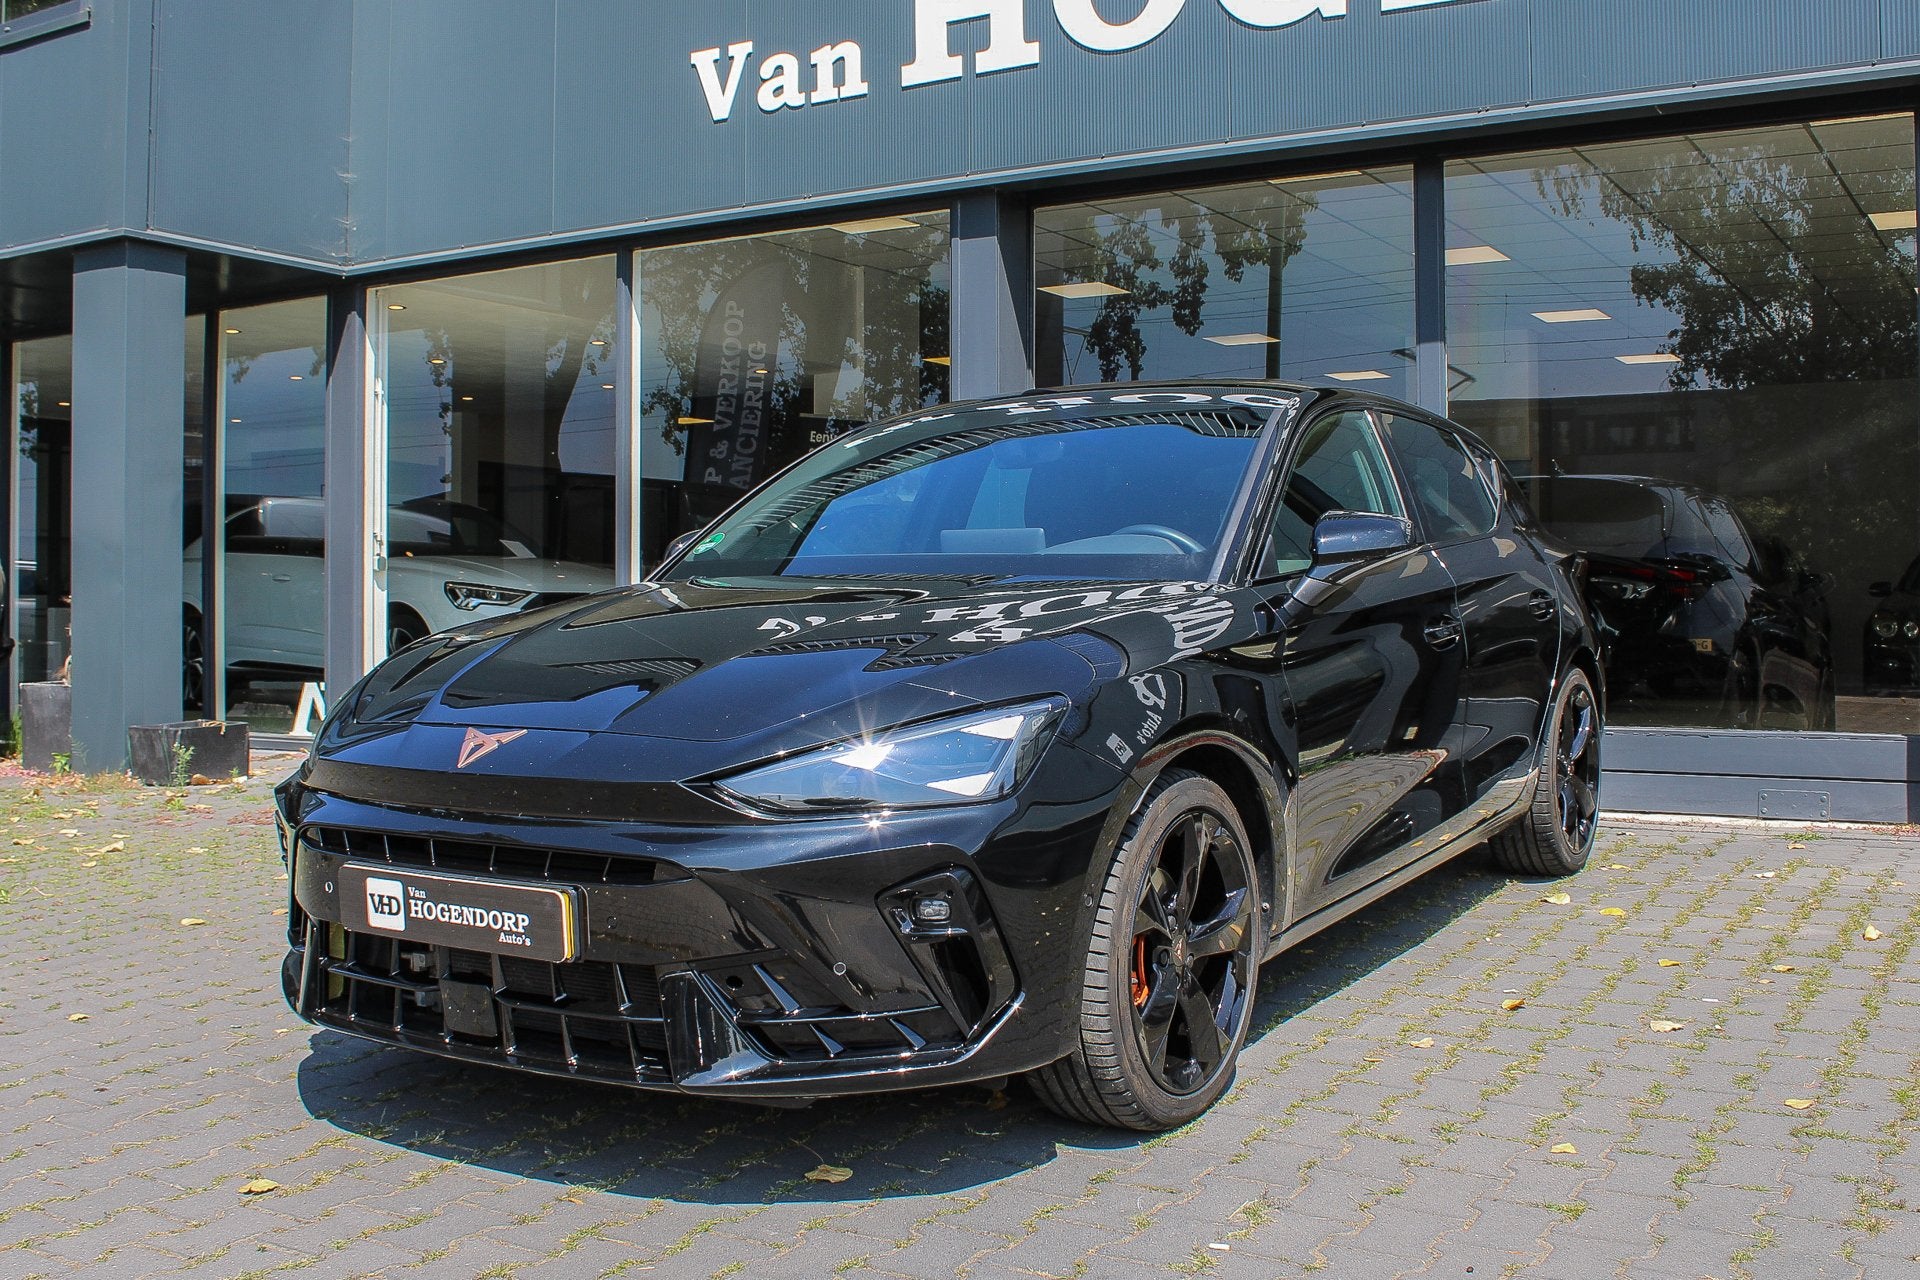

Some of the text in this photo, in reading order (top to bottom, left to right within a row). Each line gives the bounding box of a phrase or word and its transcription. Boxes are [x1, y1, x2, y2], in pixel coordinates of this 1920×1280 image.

[690, 40, 868, 122] Van
[713, 300, 744, 432] VERKOOP
[368, 893, 402, 916] VHD
[407, 886, 427, 899] Van
[408, 899, 530, 933] HOGENDORP
[498, 931, 531, 946] Auto's
